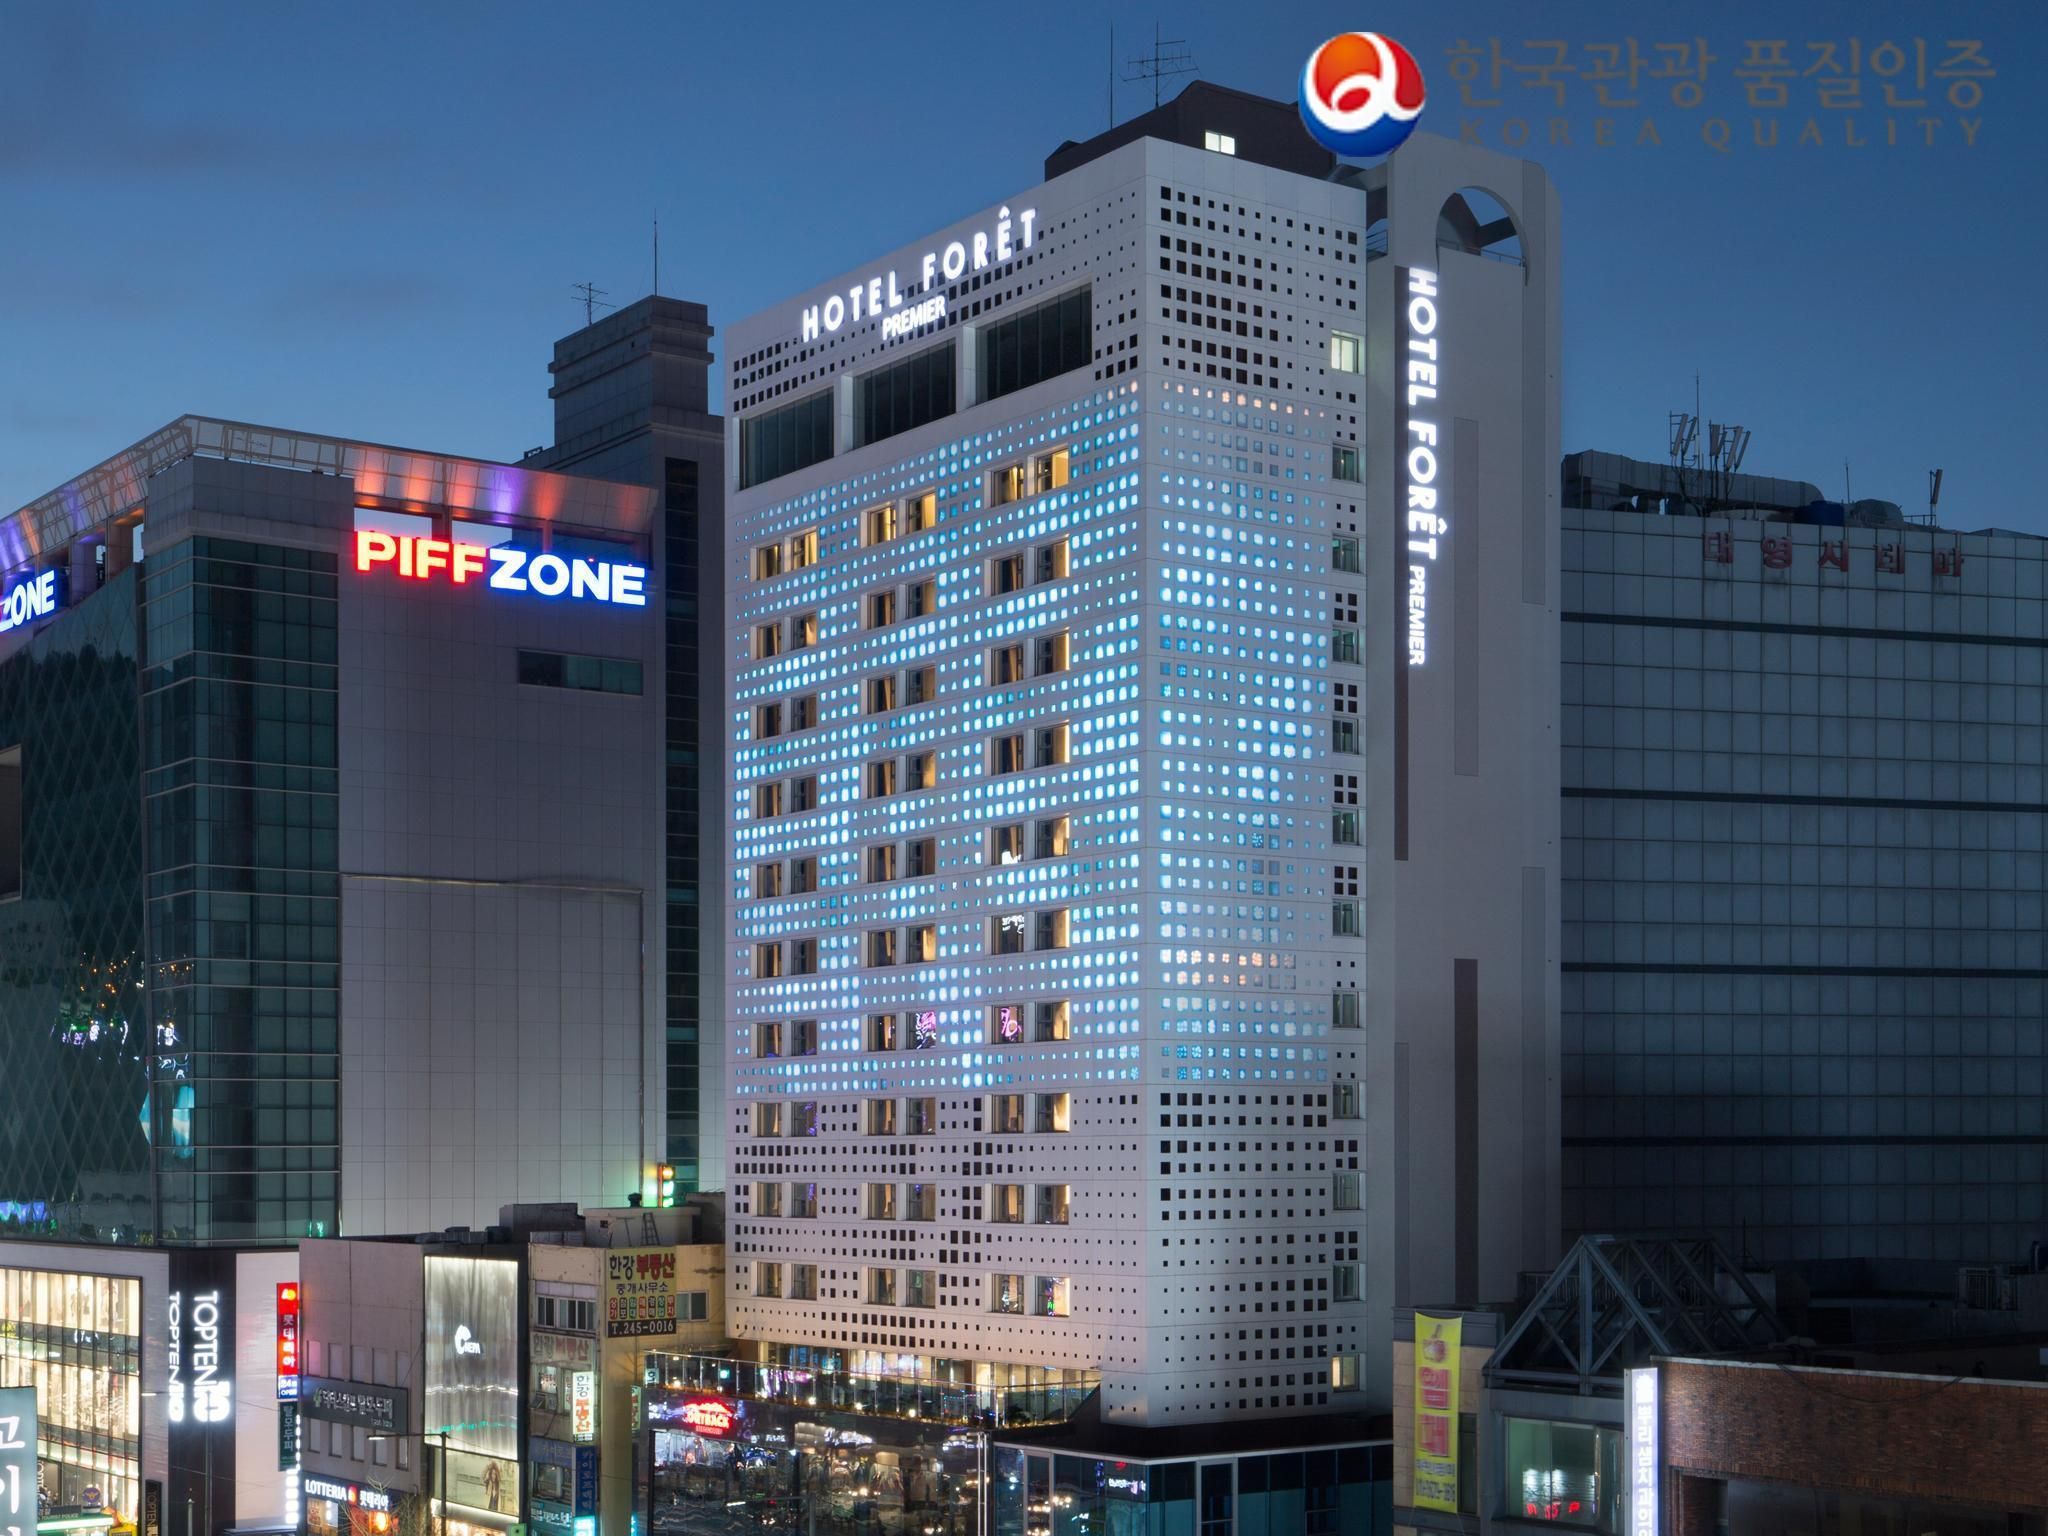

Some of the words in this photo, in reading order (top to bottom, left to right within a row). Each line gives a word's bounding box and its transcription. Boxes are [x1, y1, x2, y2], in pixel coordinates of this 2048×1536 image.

[803, 271, 902, 342] HOTEL
[922, 206, 1036, 292] FORÊT
[882, 295, 946, 340] PREMIER
[1409, 267, 1438, 406] HOTEL
[1408, 420, 1448, 560] FORÊT
[1702, 531, 1964, 578] 대영시네마
[1409, 565, 1426, 665] PREMIER
[616, 1281, 668, 1295] 중개사무소
[611, 1320, 674, 1335] T.245-0016
[305, 1480, 347, 1501] LOTTERIA
